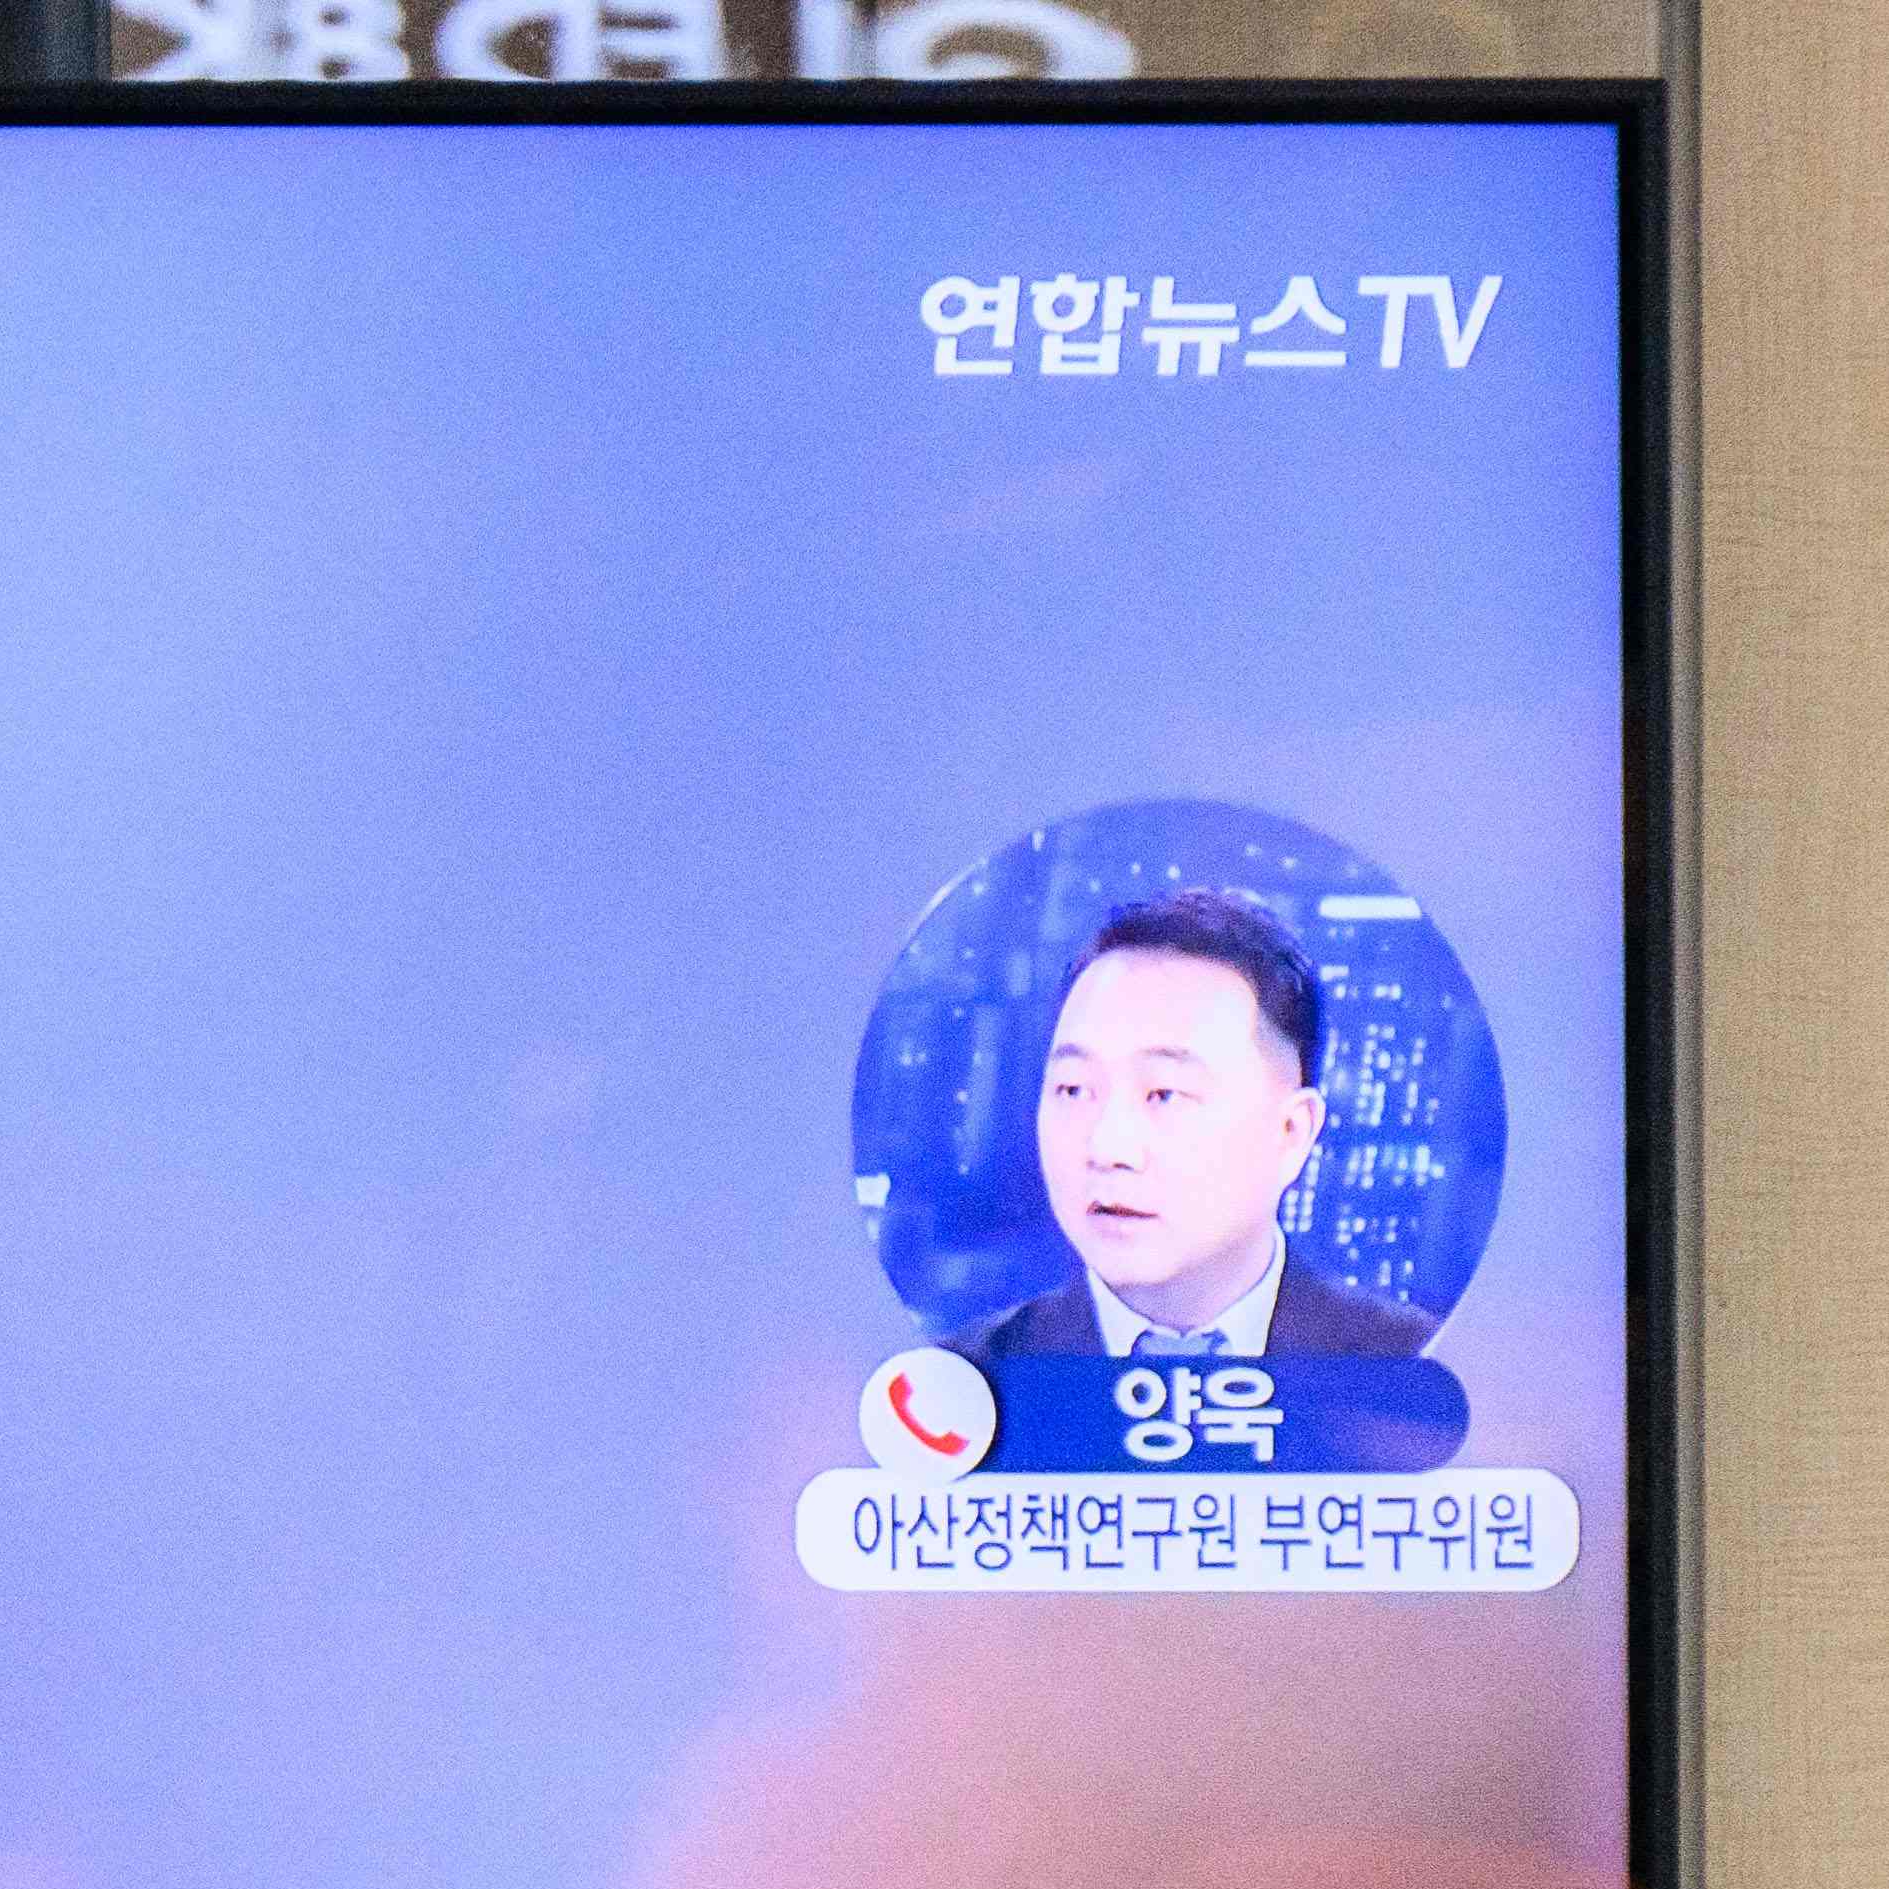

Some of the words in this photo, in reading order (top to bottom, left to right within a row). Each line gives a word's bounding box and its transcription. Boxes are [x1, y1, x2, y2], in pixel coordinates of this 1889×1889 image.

[920, 272, 1503, 378] 연합뉴스TV
[1115, 1367, 1285, 1463] 양욱
[854, 1493, 1238, 1574] 아산정책연구원
[1259, 1494, 1535, 1572] 부연구위원
